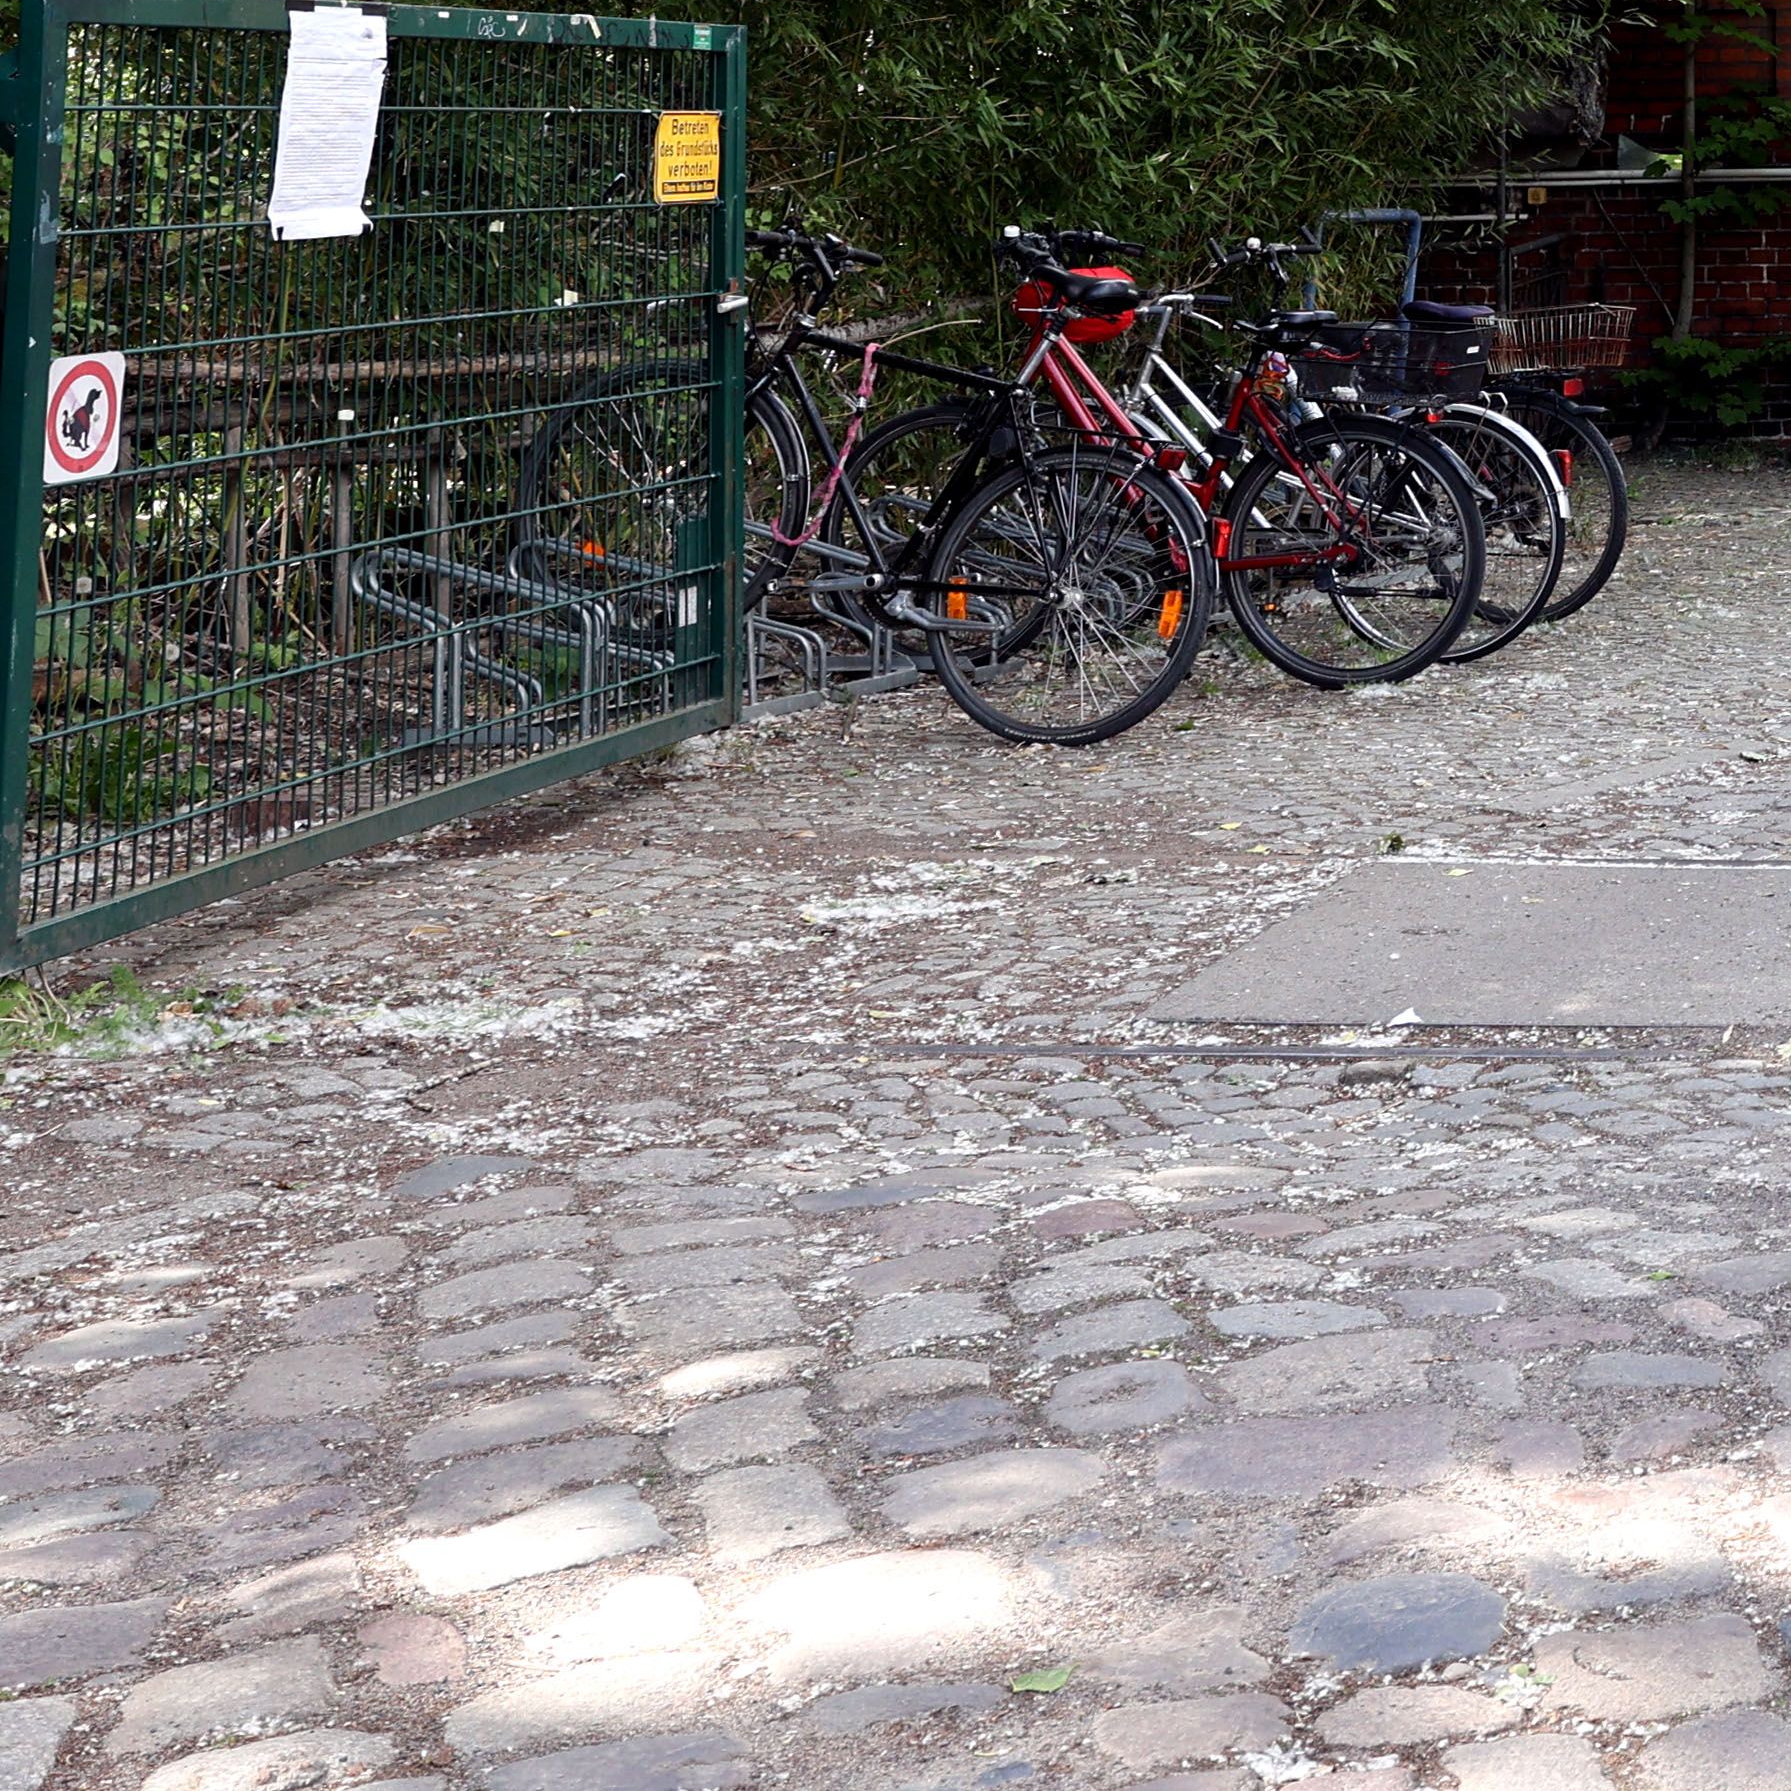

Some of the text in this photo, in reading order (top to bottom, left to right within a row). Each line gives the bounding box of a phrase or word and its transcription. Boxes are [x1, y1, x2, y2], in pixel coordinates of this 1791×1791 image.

[671, 118, 709, 135] Betreten
[660, 140, 674, 157] des
[668, 160, 713, 177] verboten!
